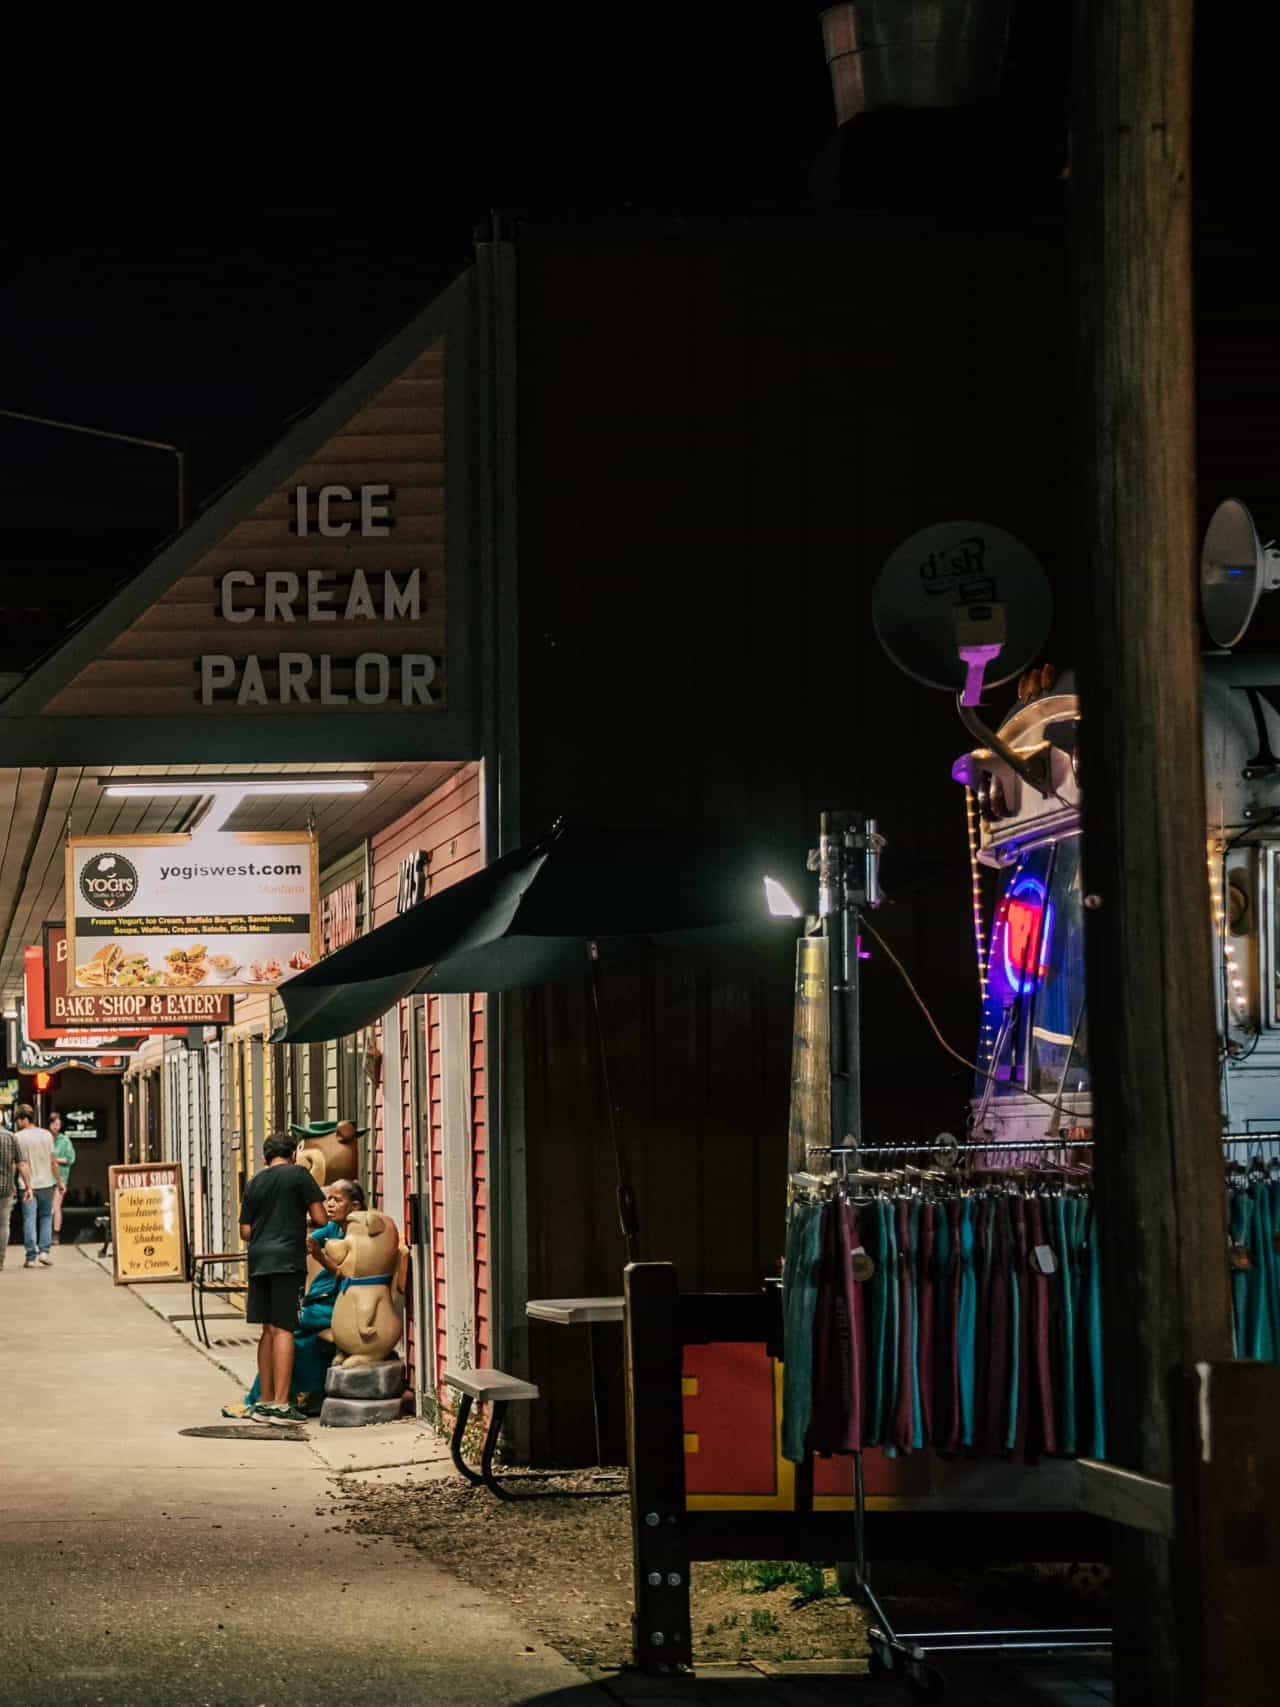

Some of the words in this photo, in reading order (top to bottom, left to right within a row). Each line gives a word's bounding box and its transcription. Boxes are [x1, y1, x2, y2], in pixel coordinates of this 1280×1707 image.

[296, 484, 391, 537] ICE
[221, 568, 421, 623] CREAM
[200, 652, 436, 706] PARLOR
[160, 863, 302, 880] yogiswest.com
[55, 997, 95, 1017] BAKE
[99, 995, 146, 1016] SHOP
[150, 996, 162, 1015] &
[167, 994, 224, 1014] EATERY
[118, 1173, 147, 1188] CANDY
[150, 1170, 175, 1186] SHOP
[128, 1195, 143, 1206] We
[135, 1207, 158, 1217] have
[144, 1260, 170, 1270] Cream
